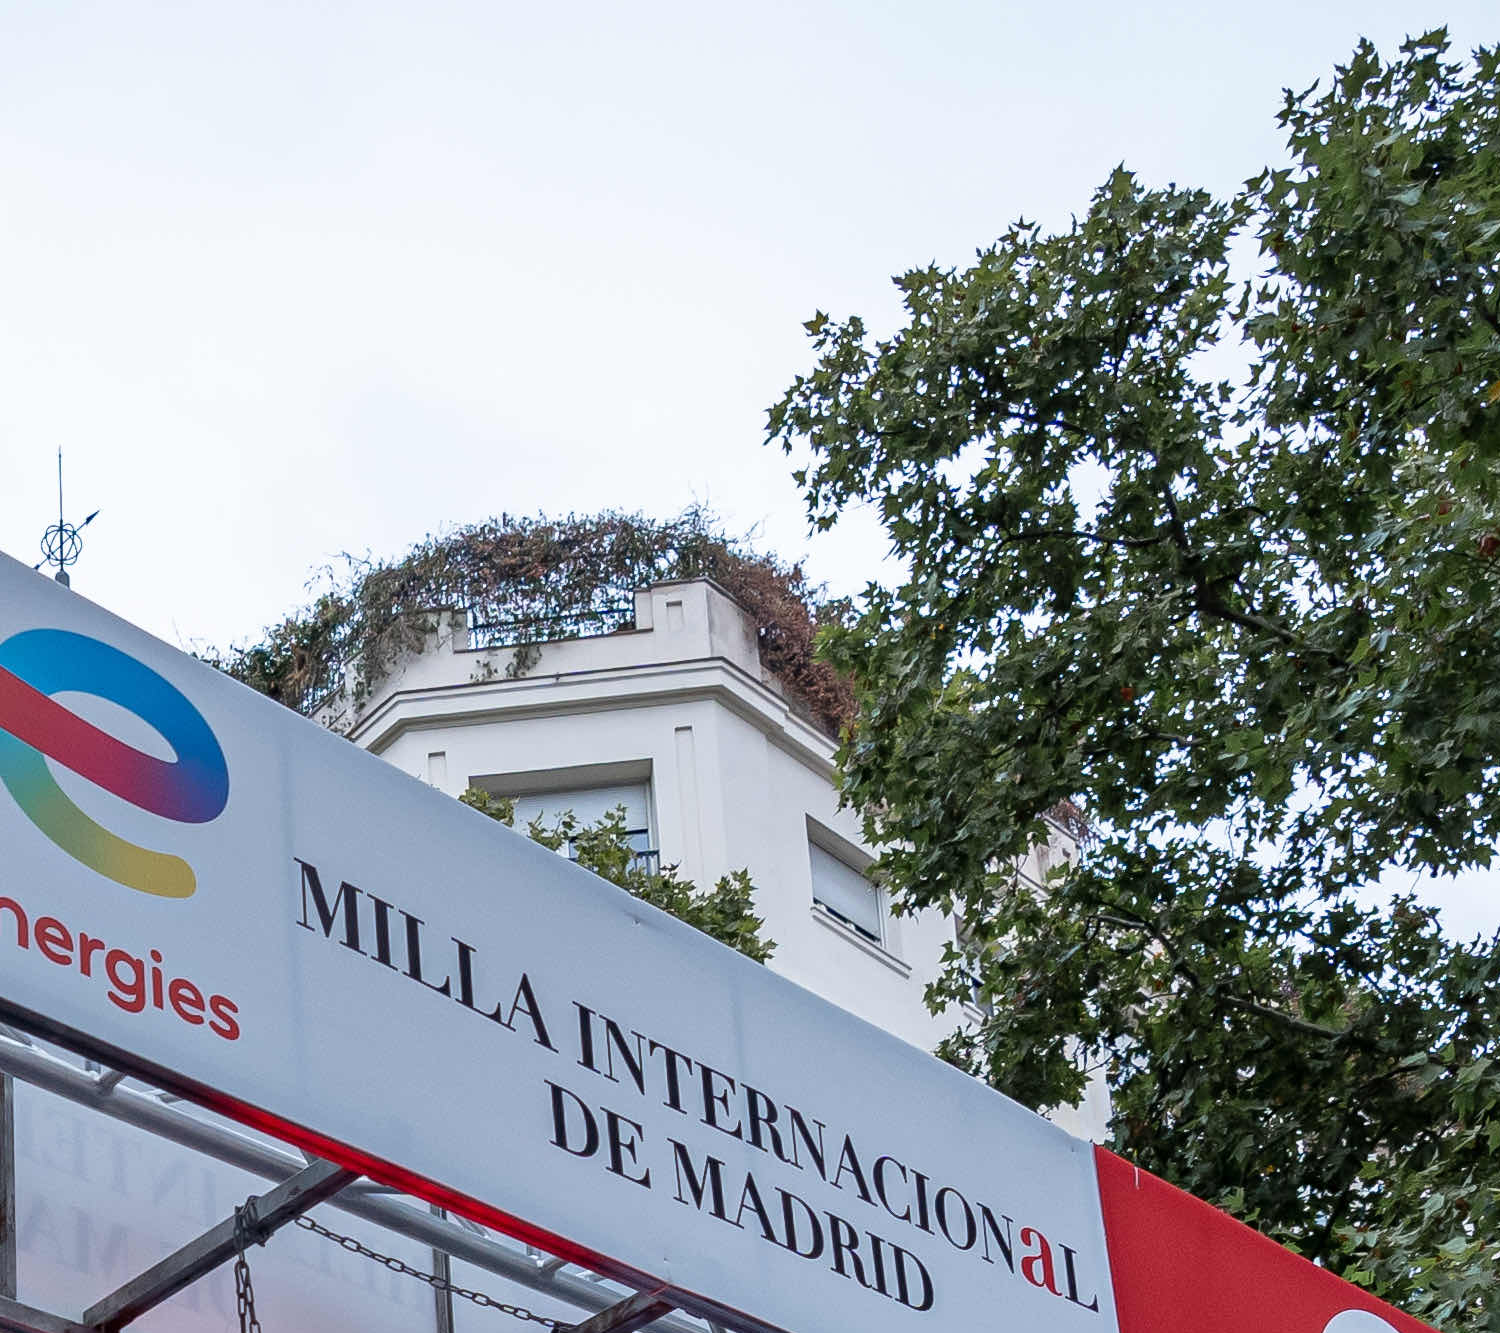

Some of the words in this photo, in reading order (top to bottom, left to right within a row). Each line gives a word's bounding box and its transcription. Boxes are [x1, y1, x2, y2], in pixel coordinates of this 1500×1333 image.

[294, 857, 559, 1054] MILLA
[544, 1079, 653, 1188] DE
[667, 1137, 936, 1313] MADRID
